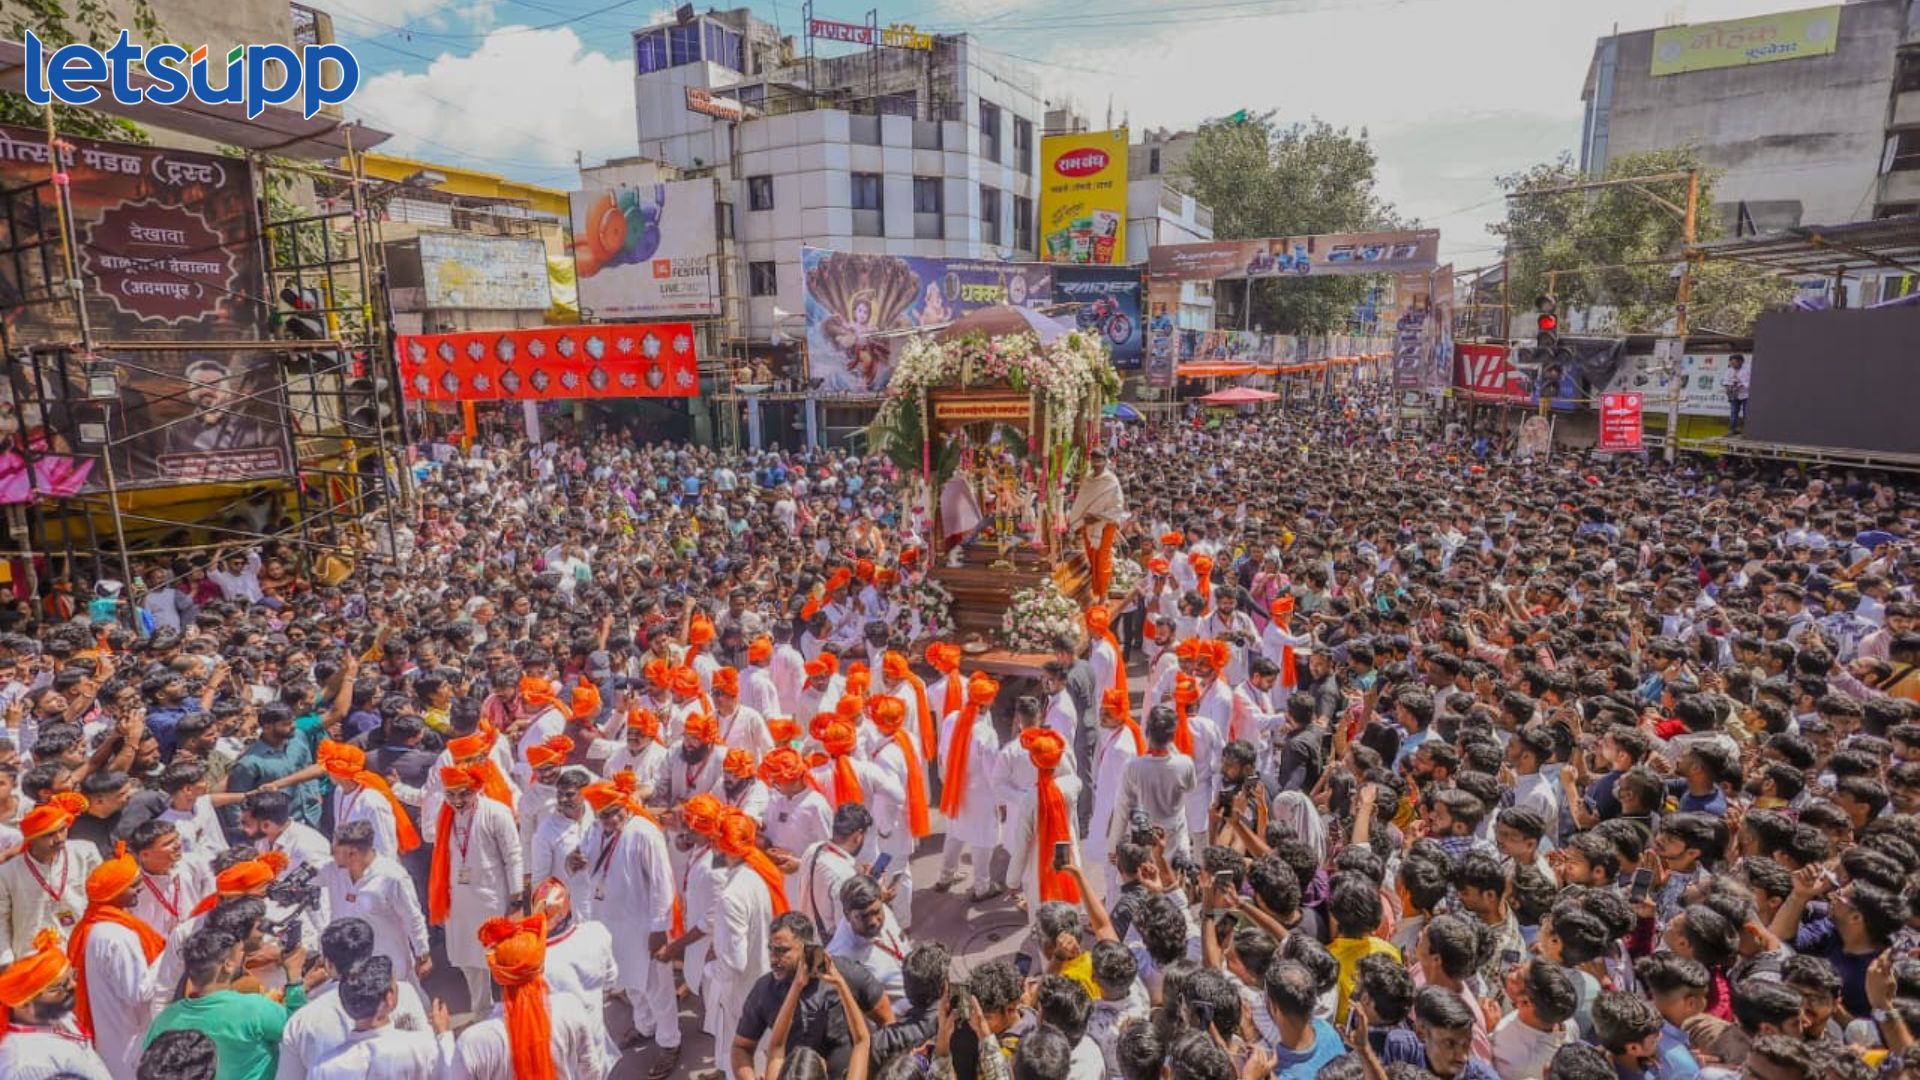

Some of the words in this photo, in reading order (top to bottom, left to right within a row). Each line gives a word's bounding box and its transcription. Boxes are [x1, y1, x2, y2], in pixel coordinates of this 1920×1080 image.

[82, 143, 141, 174] मंडळ
[151, 155, 226, 188] (ट्रस्ट)
[128, 221, 185, 243] देखावा
[1055, 282, 1139, 296] RAIDER
